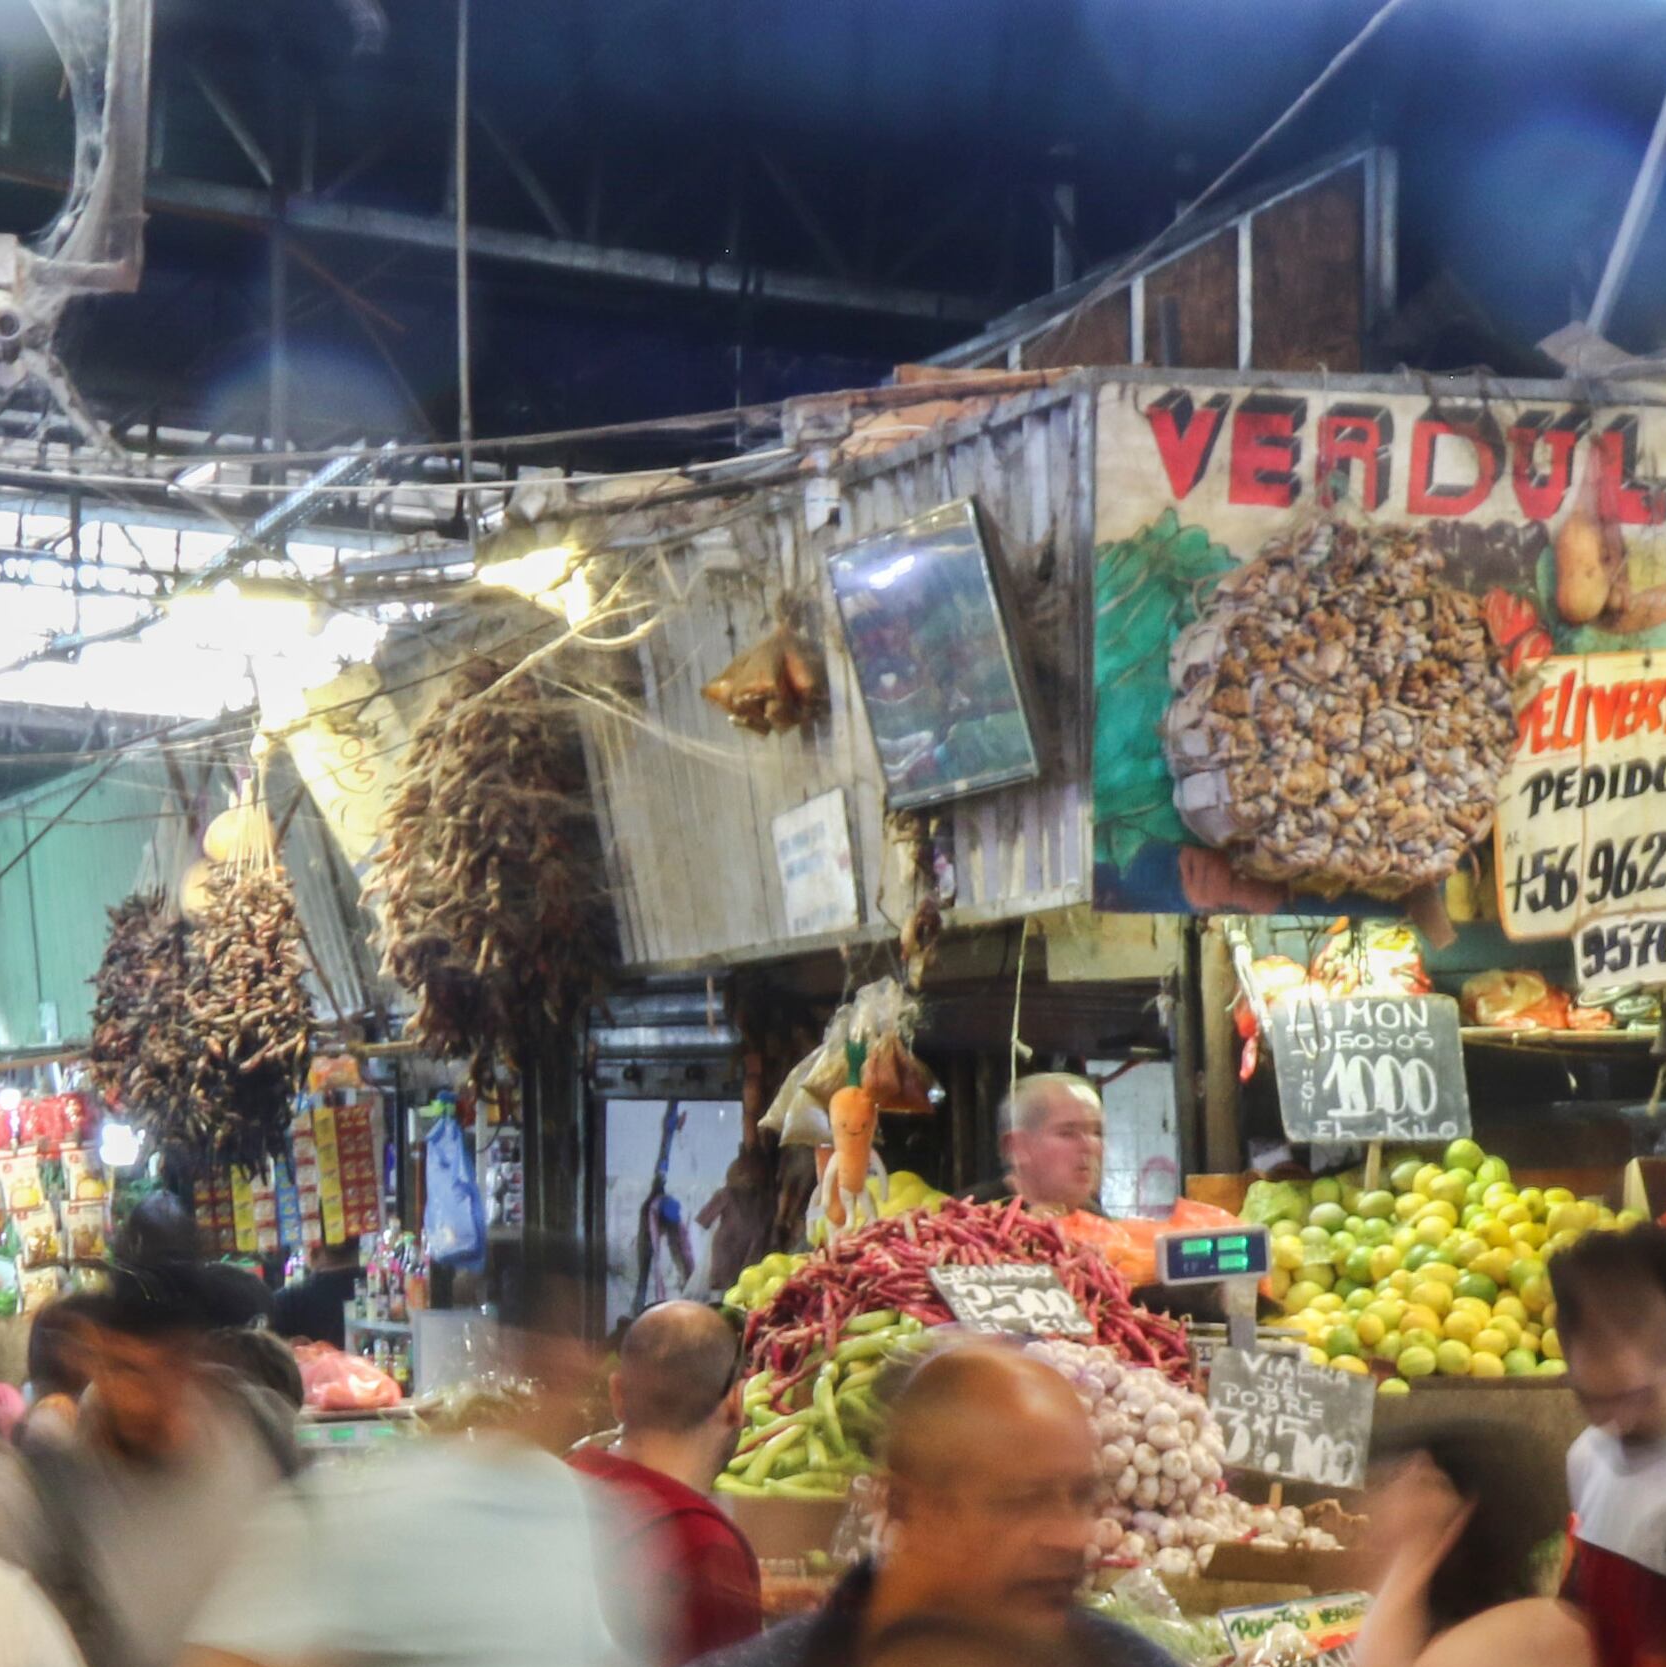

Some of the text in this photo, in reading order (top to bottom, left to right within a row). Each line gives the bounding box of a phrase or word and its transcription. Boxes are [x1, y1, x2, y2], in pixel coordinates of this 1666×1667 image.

[1505, 843, 1579, 914] +56
[1322, 1052, 1438, 1117] 1000
[1241, 1350, 1351, 1388] VIAGRA
[1257, 1375, 1313, 1399] DEL
[1219, 1381, 1326, 1429] POBRE
